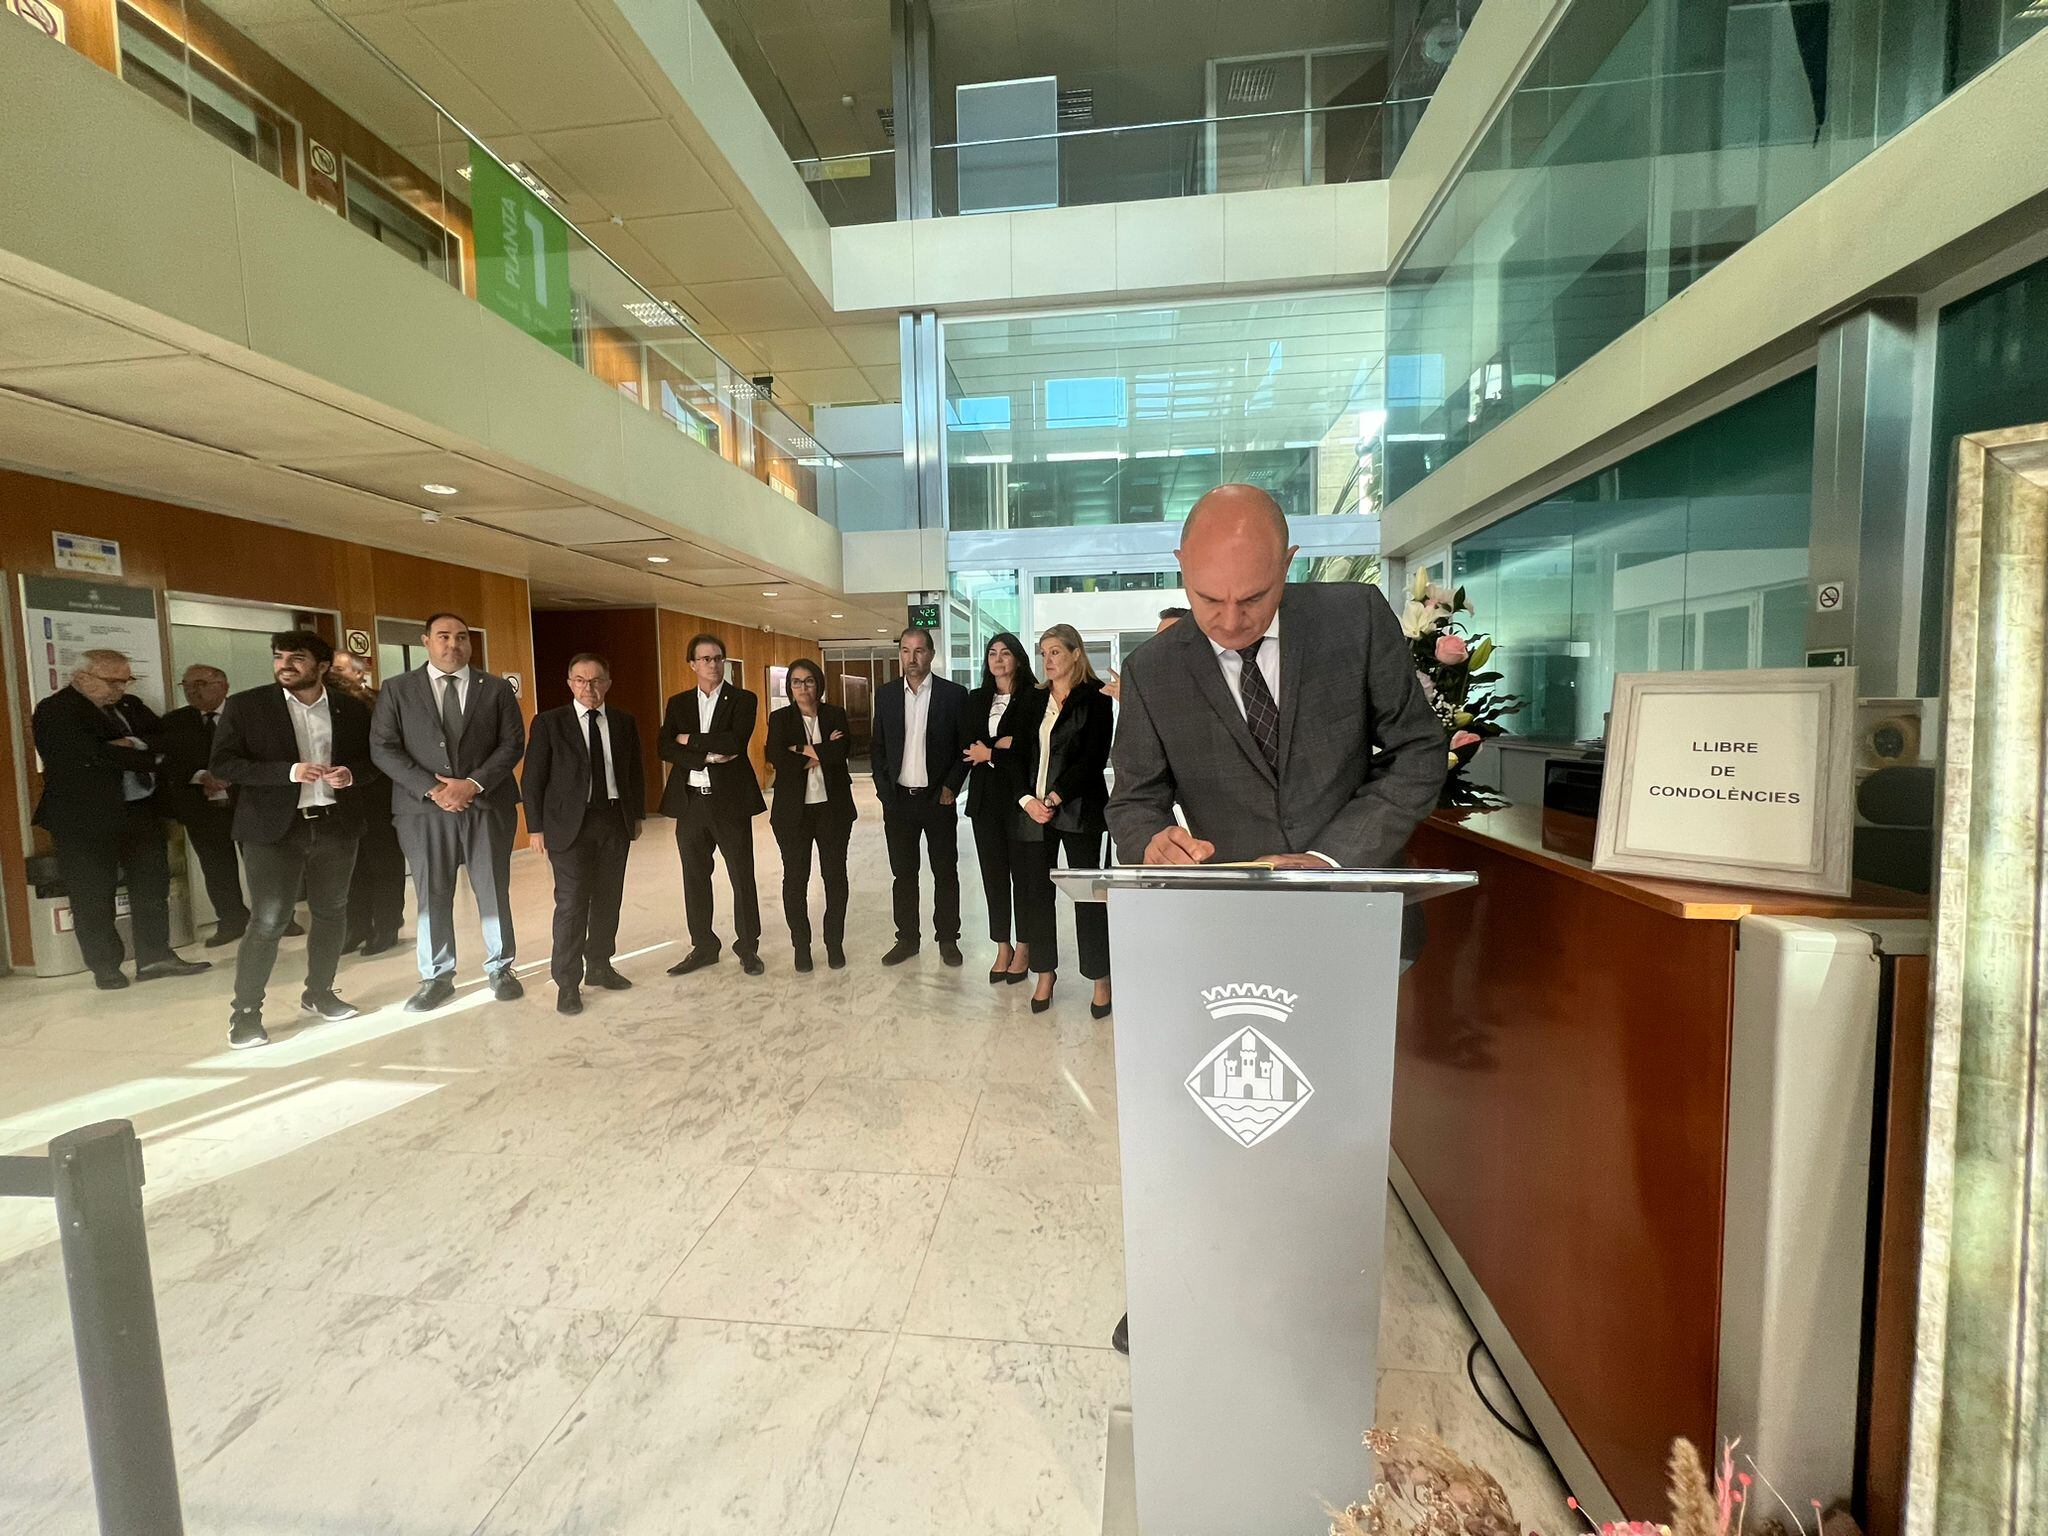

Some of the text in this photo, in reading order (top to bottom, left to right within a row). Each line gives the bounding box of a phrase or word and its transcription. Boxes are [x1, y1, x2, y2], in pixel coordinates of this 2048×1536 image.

[501, 197, 520, 289] PLANTA
[523, 209, 548, 309] 1
[1692, 741, 1758, 753] LLIBRE
[1710, 765, 1736, 777] DE
[1649, 785, 1801, 804] CONDOLÈNCIES
